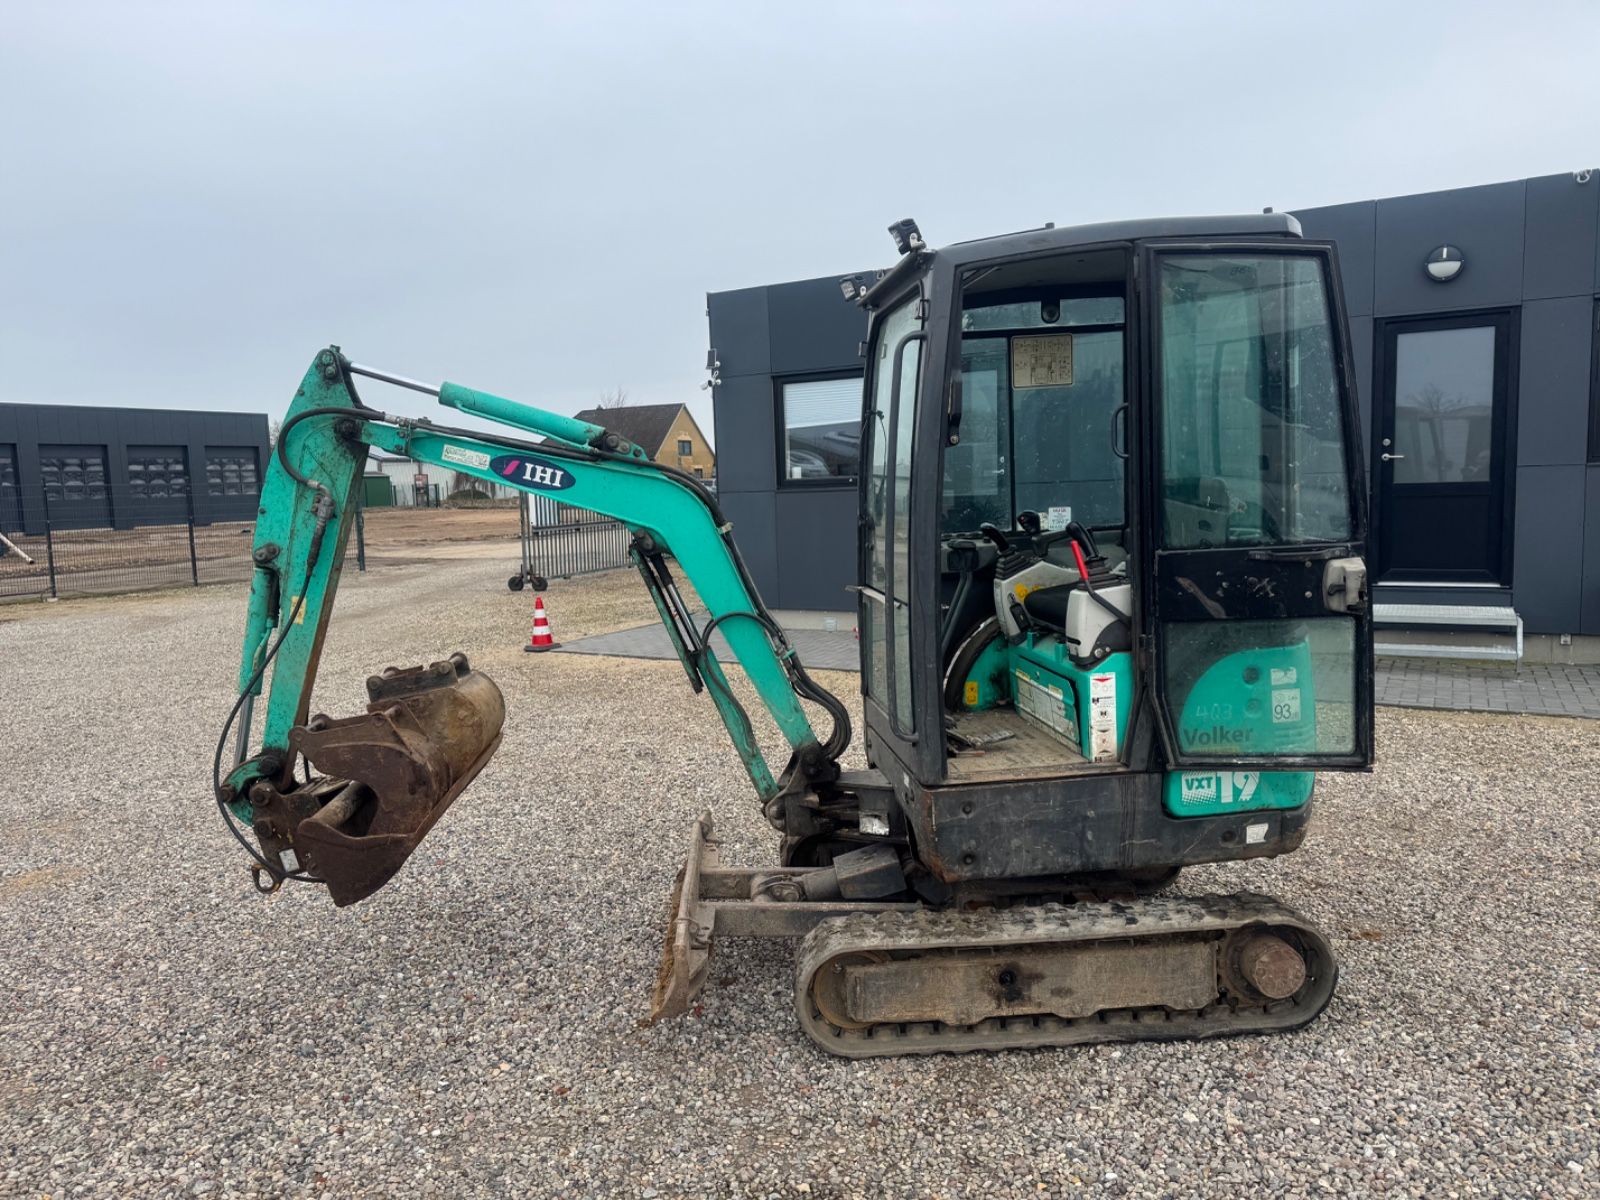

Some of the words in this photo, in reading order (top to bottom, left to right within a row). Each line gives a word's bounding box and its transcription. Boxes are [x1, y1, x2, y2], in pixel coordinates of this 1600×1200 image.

[522, 462, 564, 487] IHI
[1274, 703, 1291, 720] 93
[1183, 725, 1254, 746] Volker
[1184, 776, 1213, 791] VXT
[1216, 771, 1260, 803] 19
